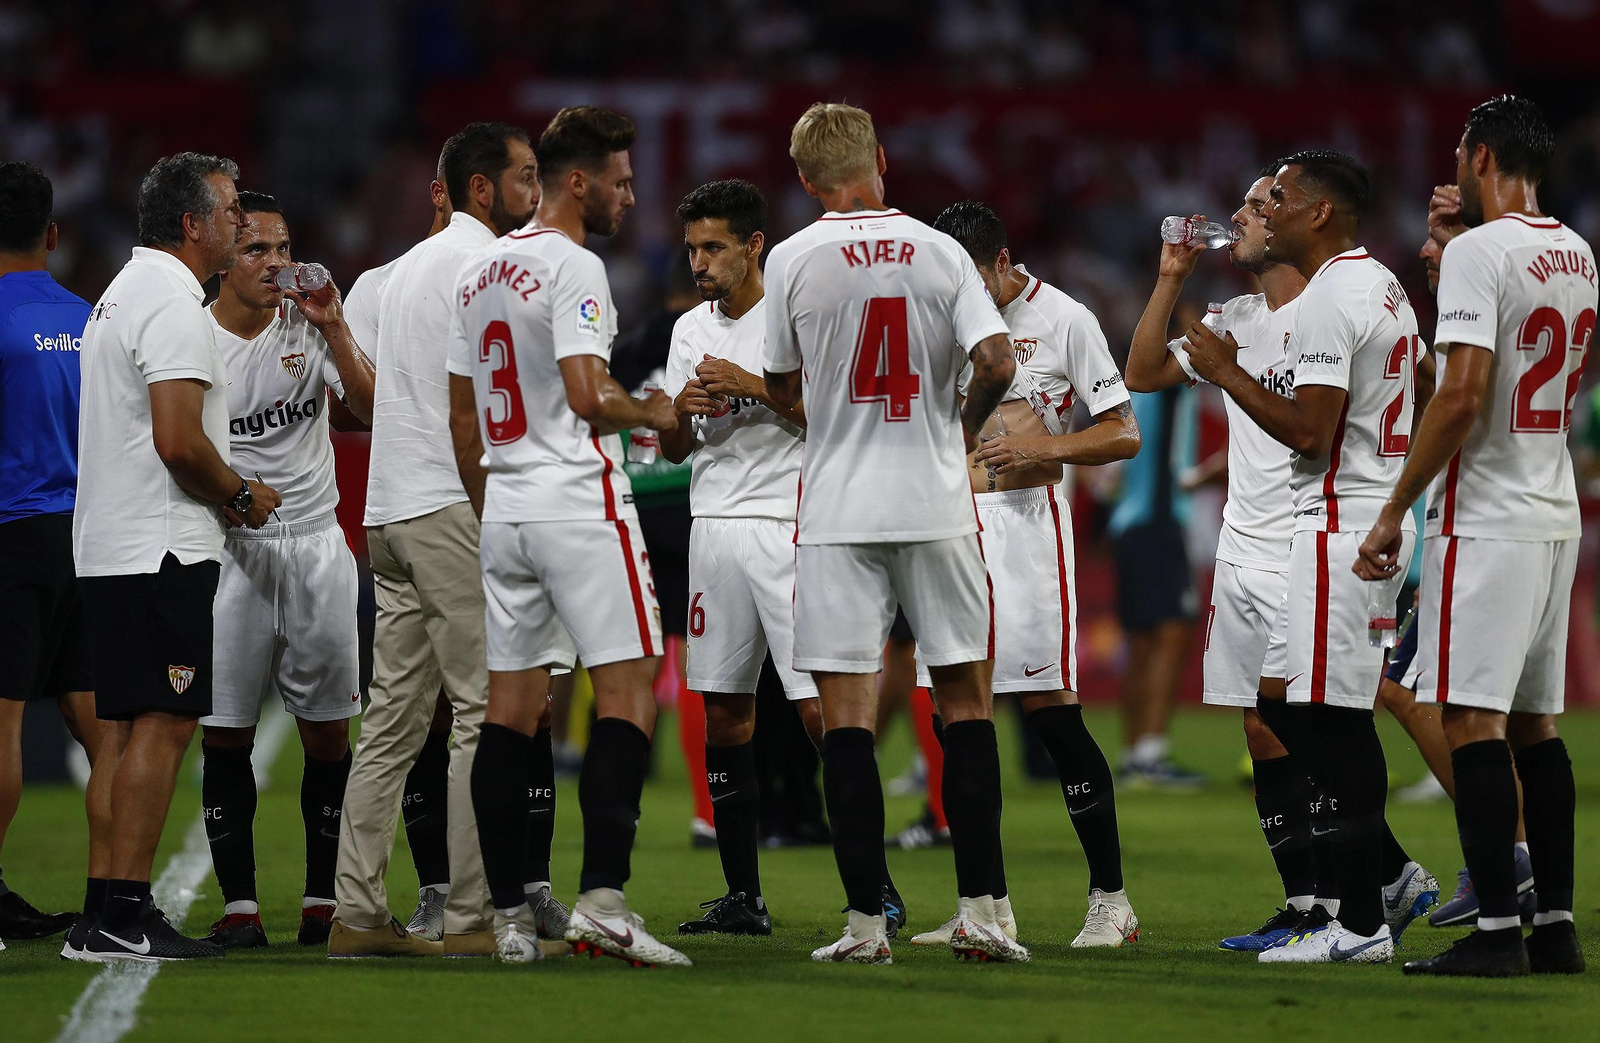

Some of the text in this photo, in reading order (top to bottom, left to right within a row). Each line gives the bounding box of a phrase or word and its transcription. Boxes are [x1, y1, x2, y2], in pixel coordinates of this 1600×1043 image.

[841, 239, 915, 268] KJÆR
[1527, 249, 1595, 288] VAZQUEZ
[33, 333, 82, 351] Sevilla
[849, 296, 920, 422] 4
[1304, 351, 1343, 365] betfair
[1510, 307, 1596, 433] 22
[479, 320, 528, 446] 3
[708, 772, 728, 784] SFC
[1067, 782, 1090, 796] SFC
[1260, 814, 1283, 829] SFC
